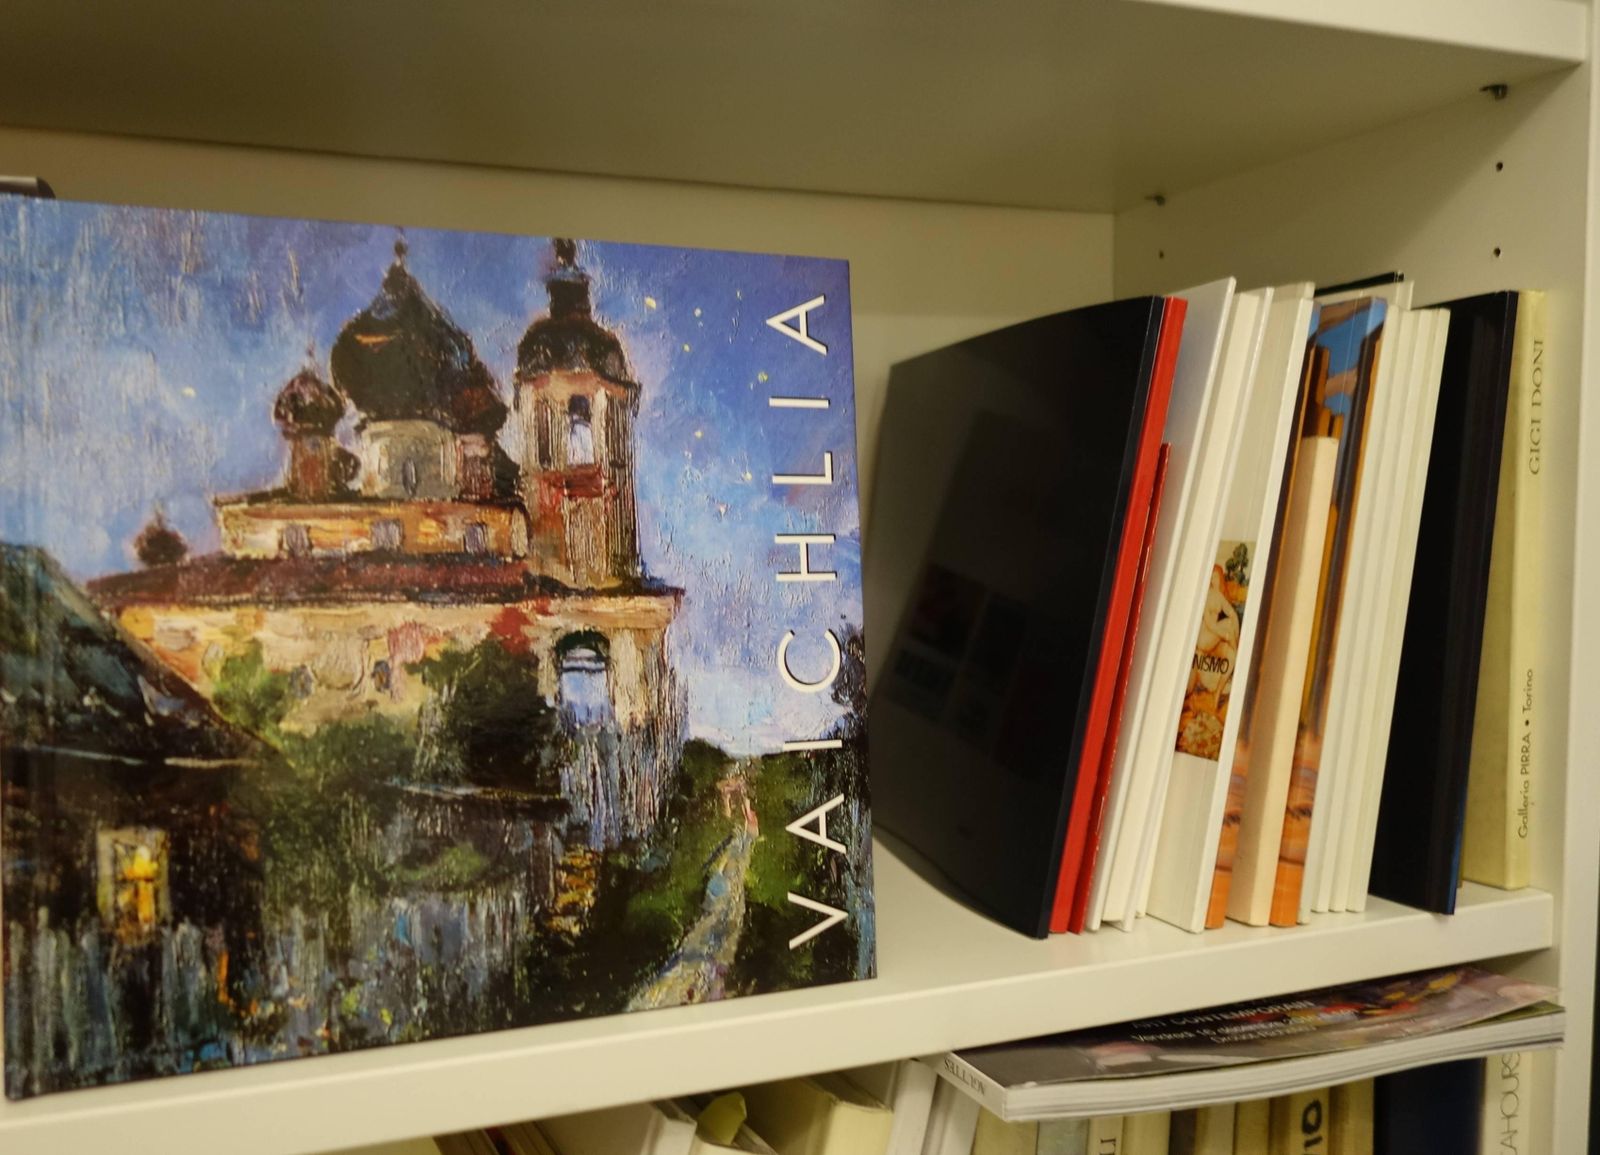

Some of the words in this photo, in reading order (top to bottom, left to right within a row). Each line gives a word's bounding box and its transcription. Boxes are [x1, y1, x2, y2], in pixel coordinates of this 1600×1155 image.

[1531, 338, 1544, 407] DONI
[1528, 419, 1542, 476] GIGI
[766, 295, 849, 950] VAICHLIA
[1522, 668, 1534, 715] Torino
[1520, 731, 1533, 776] PIRRA
[1517, 779, 1531, 839] Galleria
